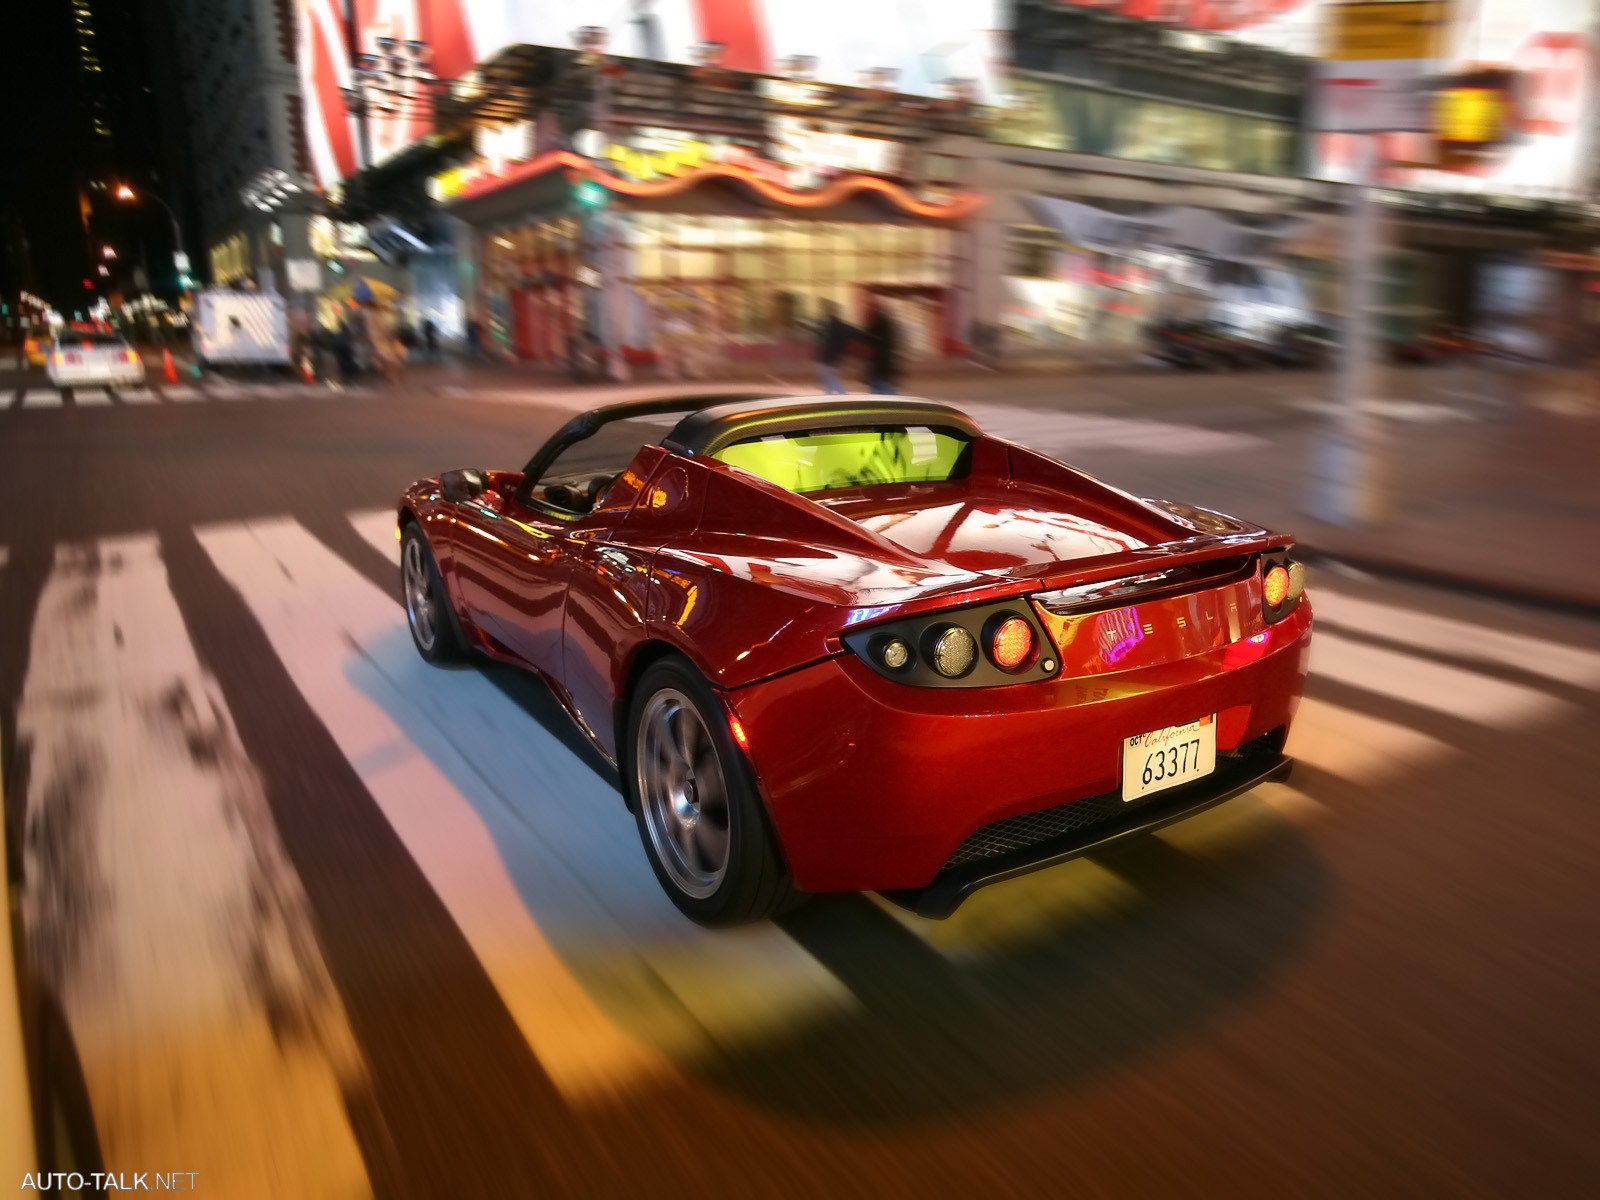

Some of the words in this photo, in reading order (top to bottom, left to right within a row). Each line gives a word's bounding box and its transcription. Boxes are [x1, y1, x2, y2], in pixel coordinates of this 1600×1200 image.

[1106, 602, 1238, 641] TESLA
[1129, 734, 1143, 747] OCT
[1144, 724, 1200, 747] California
[1142, 738, 1200, 785] 63377
